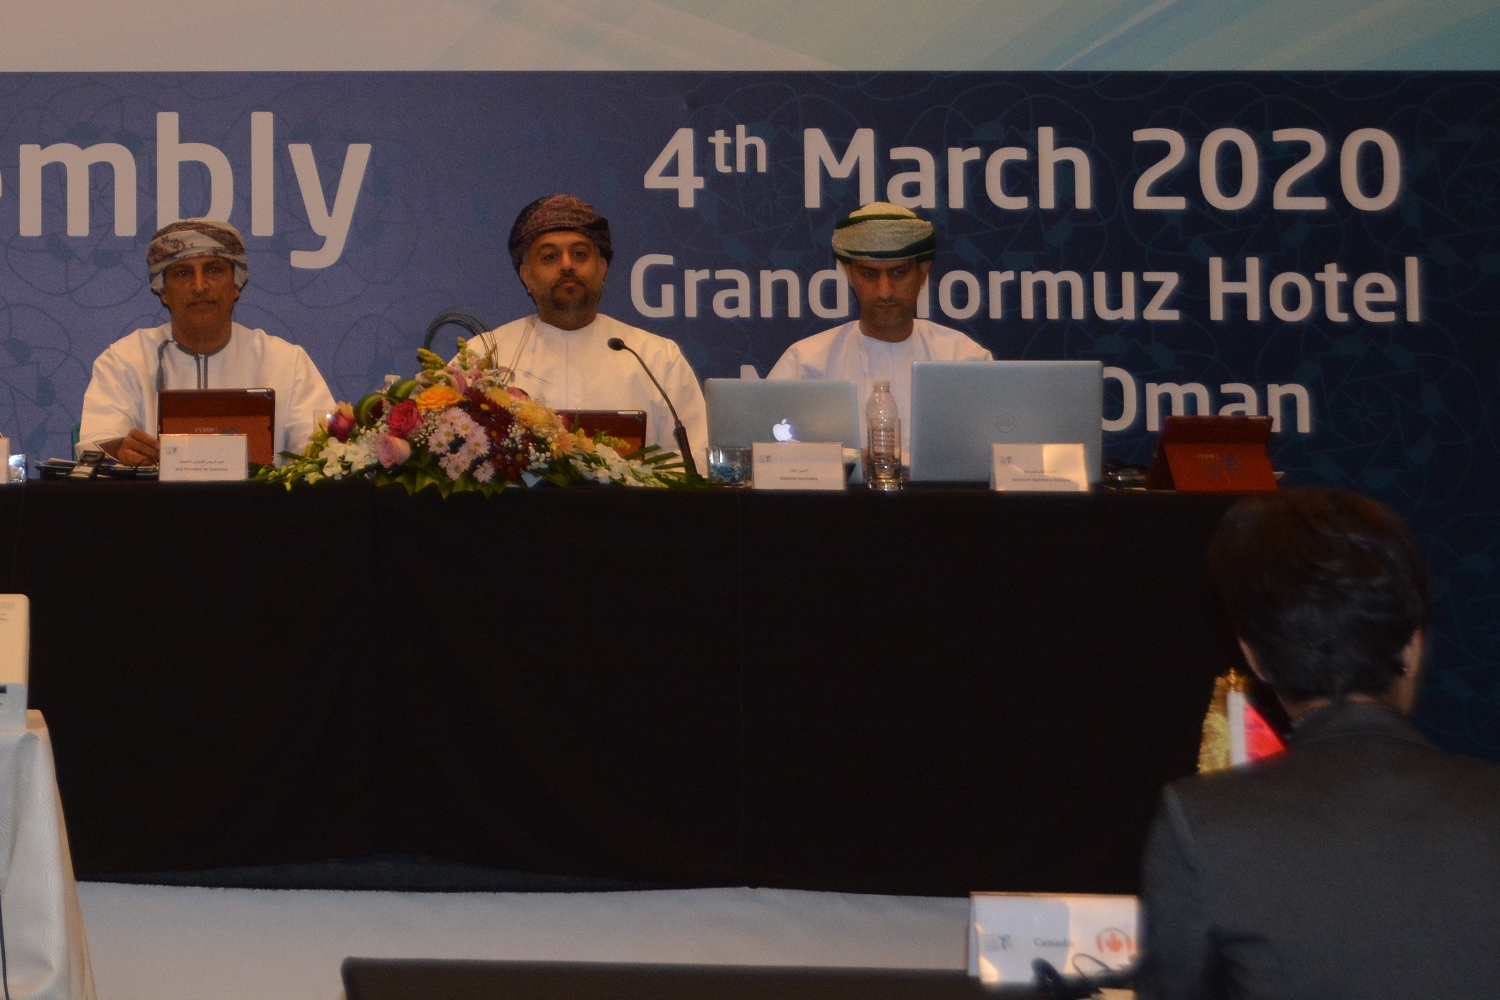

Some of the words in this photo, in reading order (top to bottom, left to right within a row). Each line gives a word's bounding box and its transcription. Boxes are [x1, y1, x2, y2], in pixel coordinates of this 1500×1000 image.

[644, 125, 767, 208] 4th
[804, 127, 1091, 209] March
[1133, 128, 1401, 211] 2020
[630, 254, 849, 319] Grand
[1209, 257, 1420, 322] Hotel
[1102, 366, 1310, 433] Oman
